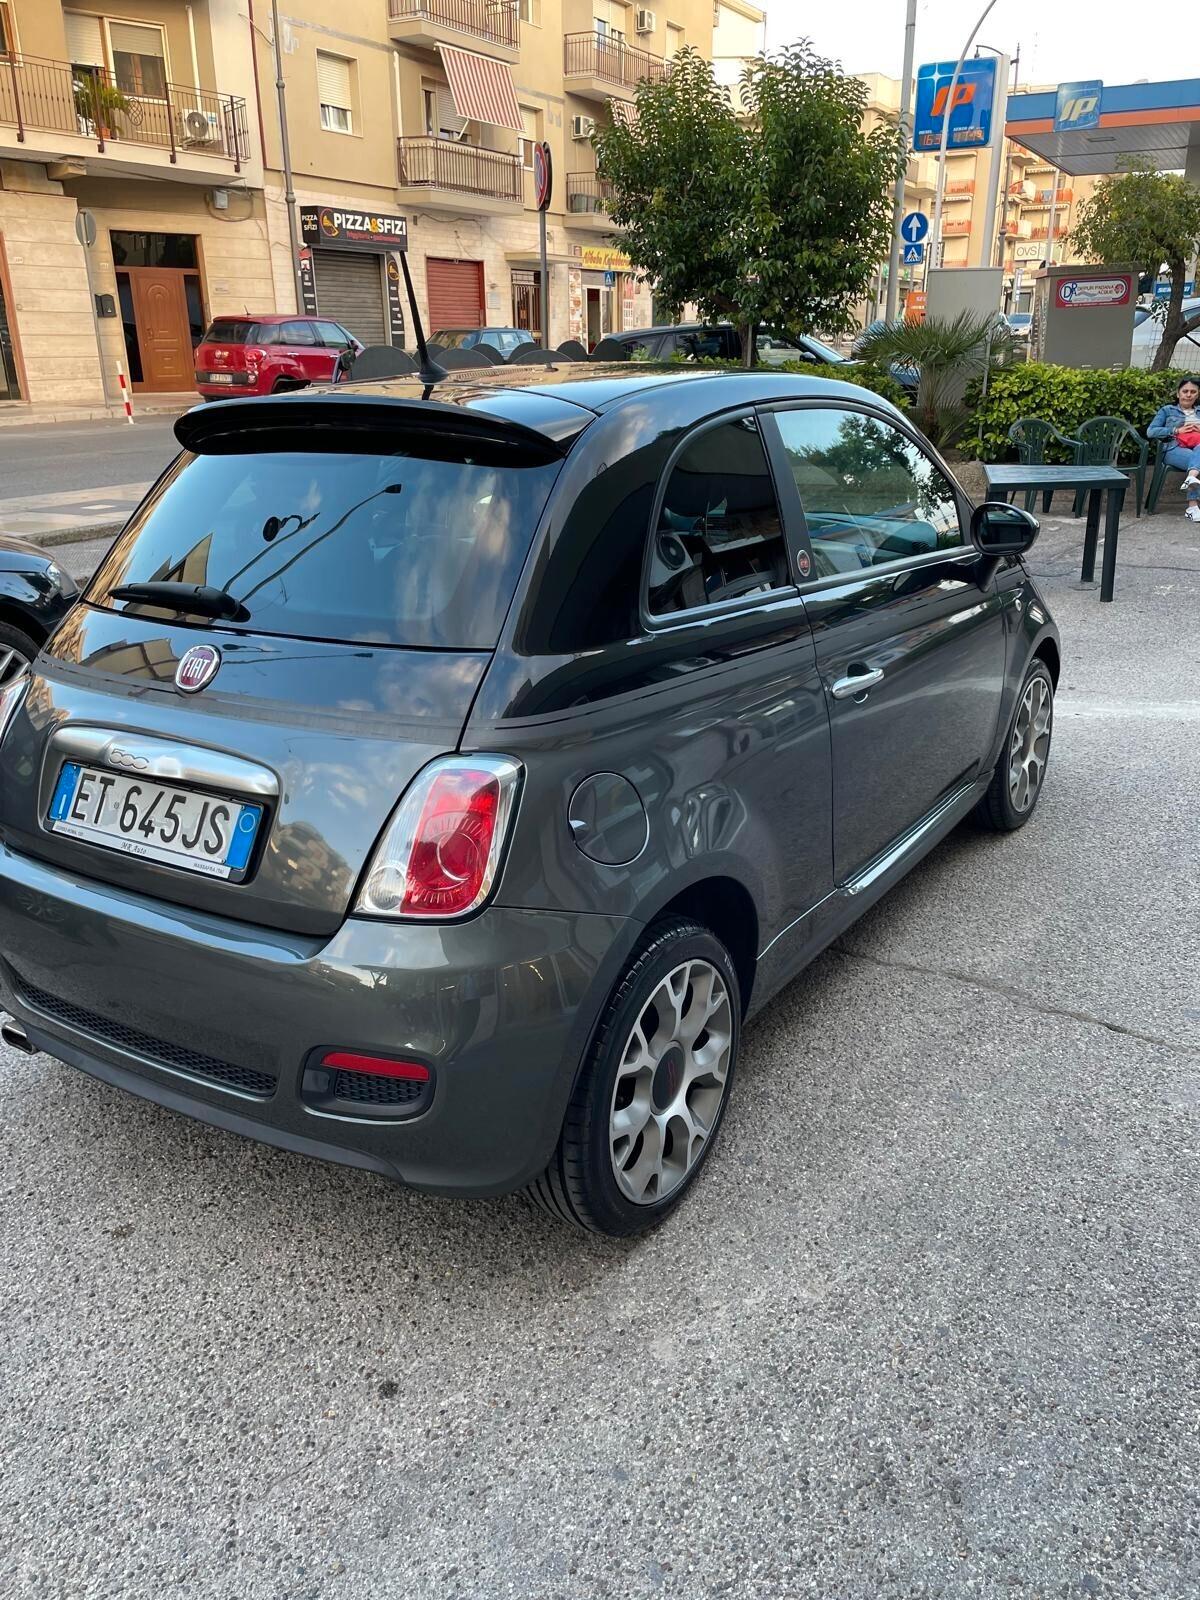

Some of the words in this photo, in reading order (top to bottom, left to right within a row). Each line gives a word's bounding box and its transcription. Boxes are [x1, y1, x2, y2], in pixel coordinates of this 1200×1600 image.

[1060, 97, 1098, 121] IP
[1016, 246, 1037, 256] OVS
[182, 657, 211, 680] FIAT
[108, 749, 149, 770] 500
